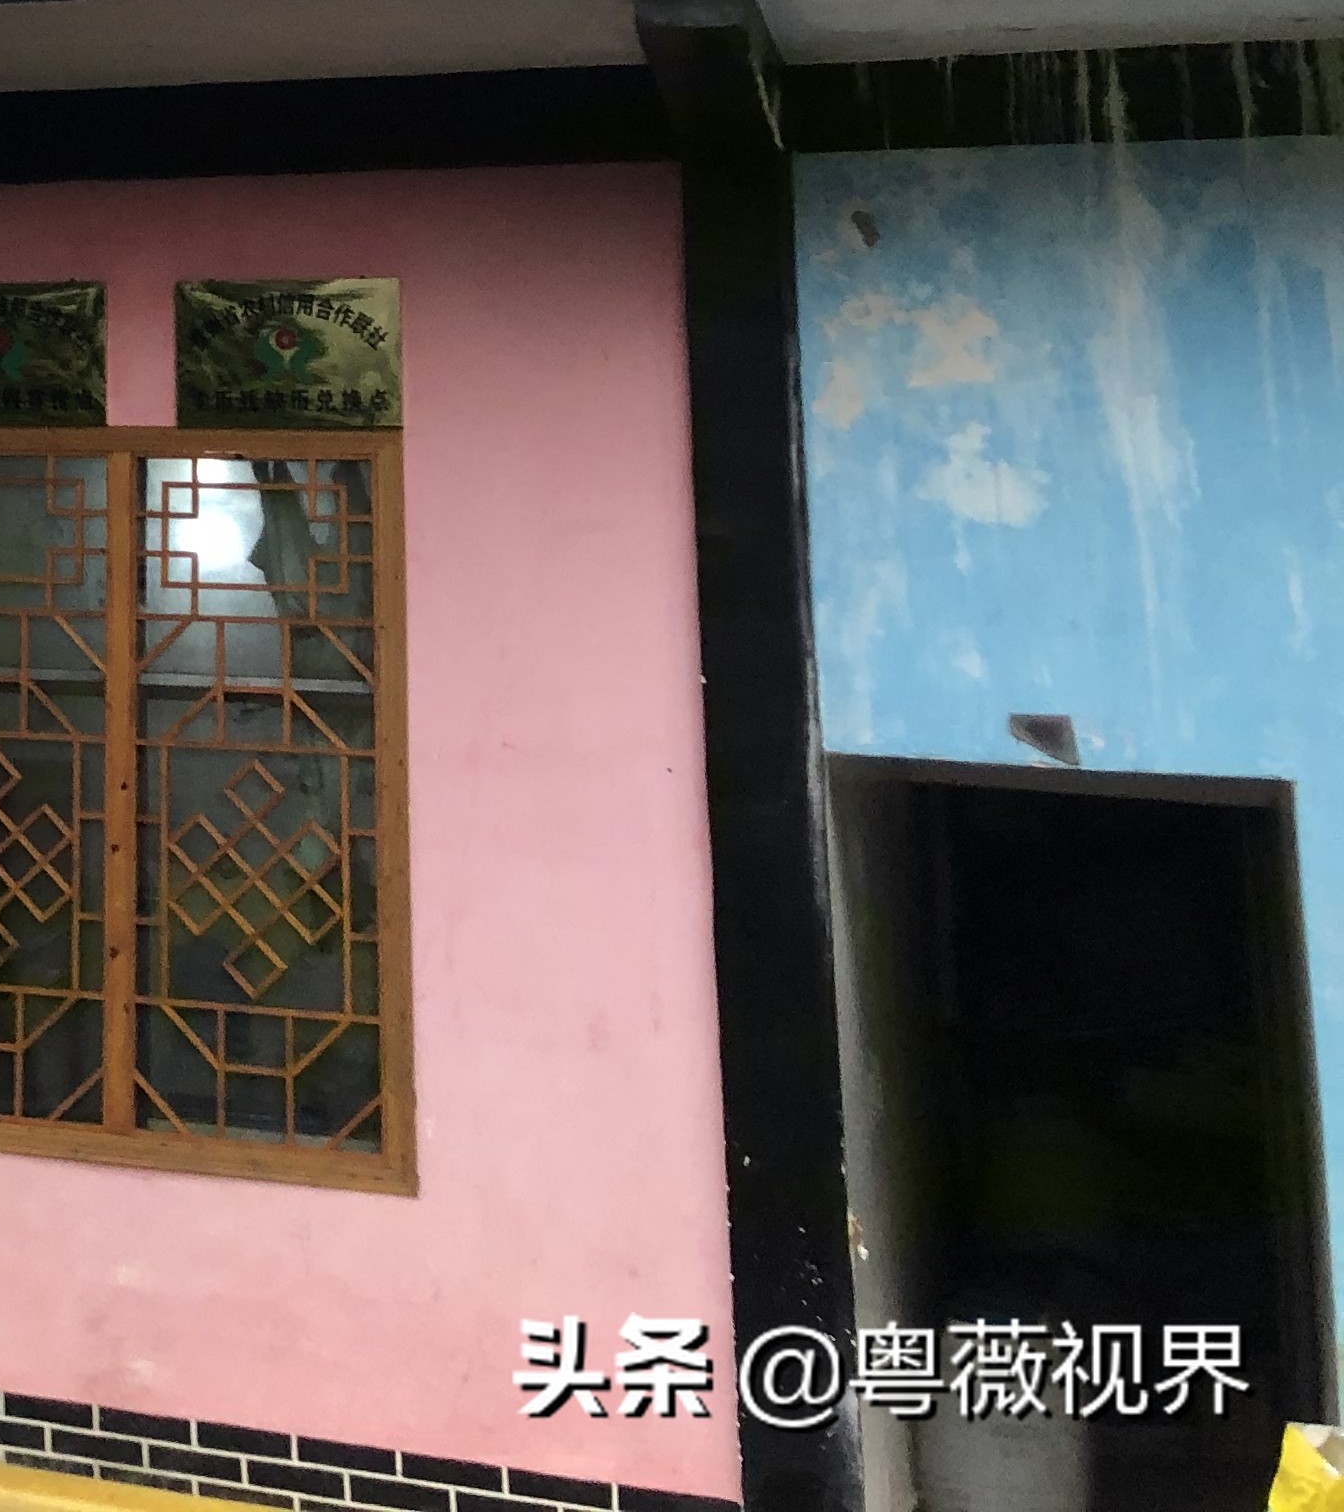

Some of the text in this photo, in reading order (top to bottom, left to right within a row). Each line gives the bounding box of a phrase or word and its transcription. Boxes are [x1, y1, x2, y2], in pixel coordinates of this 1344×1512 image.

[190, 292, 390, 351] 省农村信用合作联社
